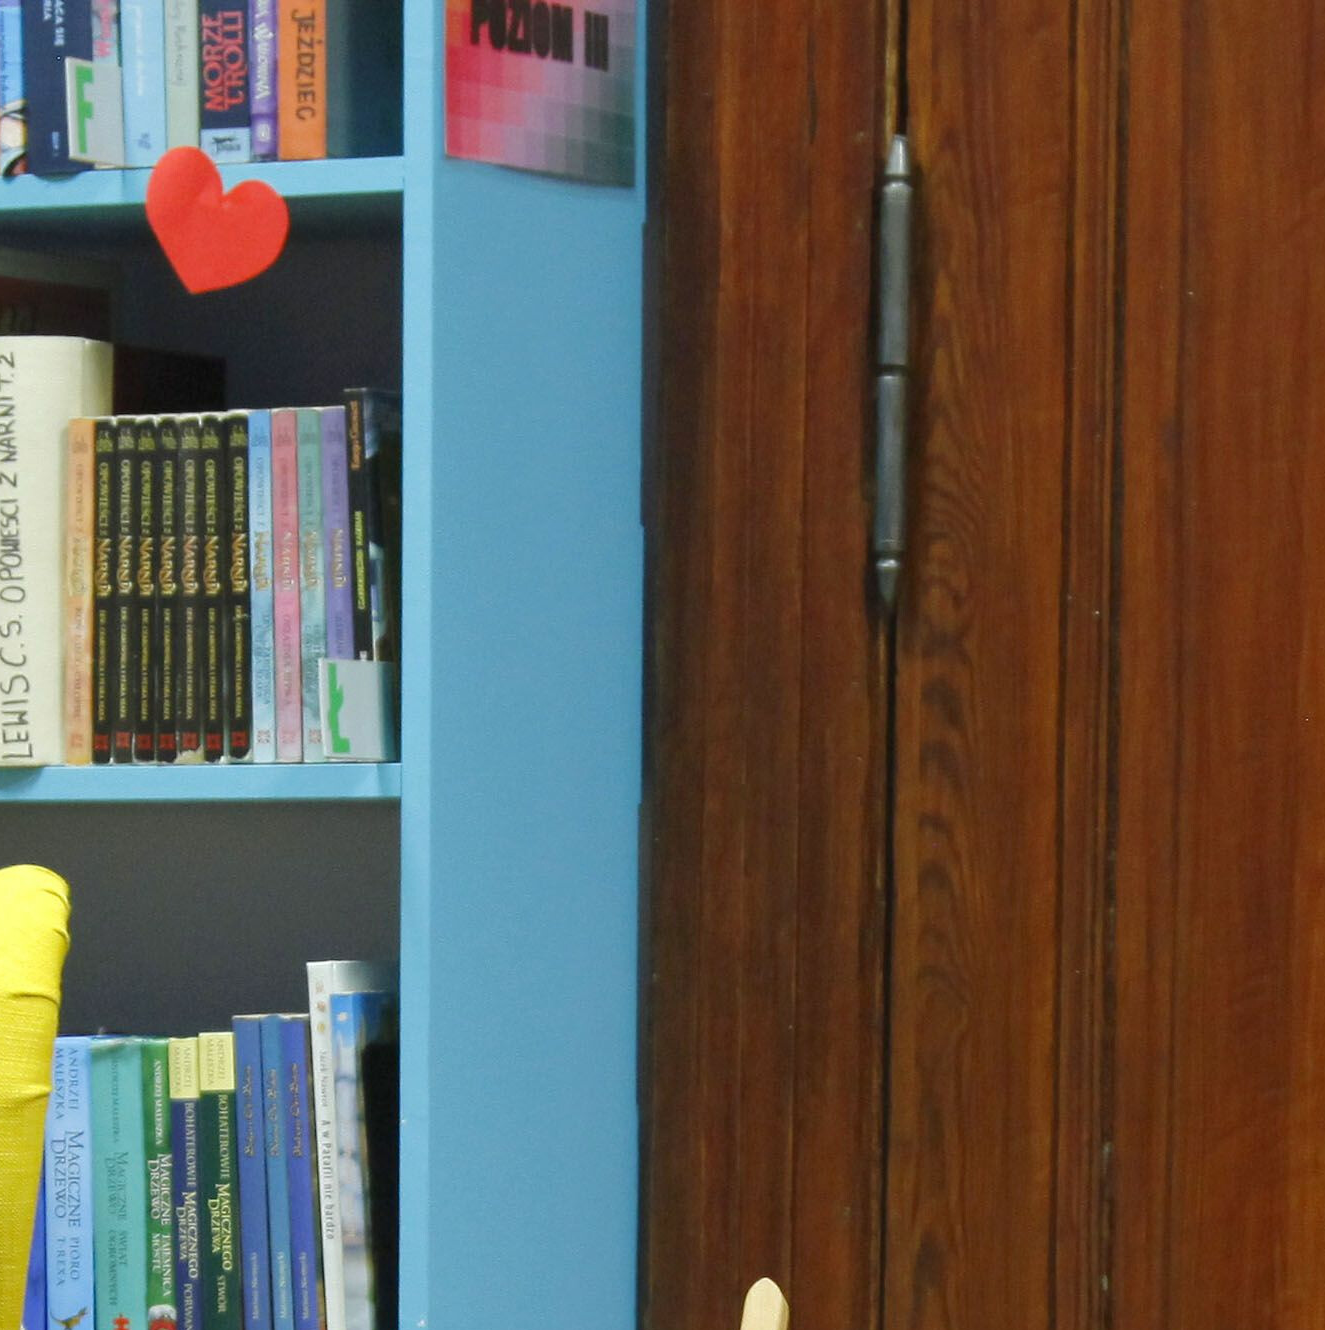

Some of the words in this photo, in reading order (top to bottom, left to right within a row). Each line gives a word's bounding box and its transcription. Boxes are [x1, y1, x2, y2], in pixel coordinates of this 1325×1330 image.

[75, 65, 94, 155] F
[0, 471, 18, 487] Z
[98, 462, 109, 528] OPOWIEŚCI
[120, 459, 130, 525] OPOWIEŚCI
[140, 460, 151, 526] OPOWIEŚCI
[162, 460, 173, 526] OPOWIEŚCI
[0, 674, 33, 760] LEWIS
[185, 1102, 197, 1187] BOHATEROWIE
[218, 1094, 231, 1180] BOHATEROWIE
[50, 1139, 68, 1220] DRZEWO
[65, 1130, 85, 1227] MAGICZNE
[148, 1159, 163, 1220] DRZEWO
[156, 1153, 173, 1226] MAGICZNE
[324, 1184, 334, 1200] nie
[151, 1233, 161, 1273] MOSTU
[176, 1206, 190, 1261] DRZEWA
[181, 1191, 199, 1278] MAGICZNEGO
[207, 1198, 221, 1253] DRZEWA
[215, 1183, 233, 1271] MAGICZNEGO
[324, 1204, 336, 1240] bardzo
[160, 1233, 172, 1297] TAJEMNICA
